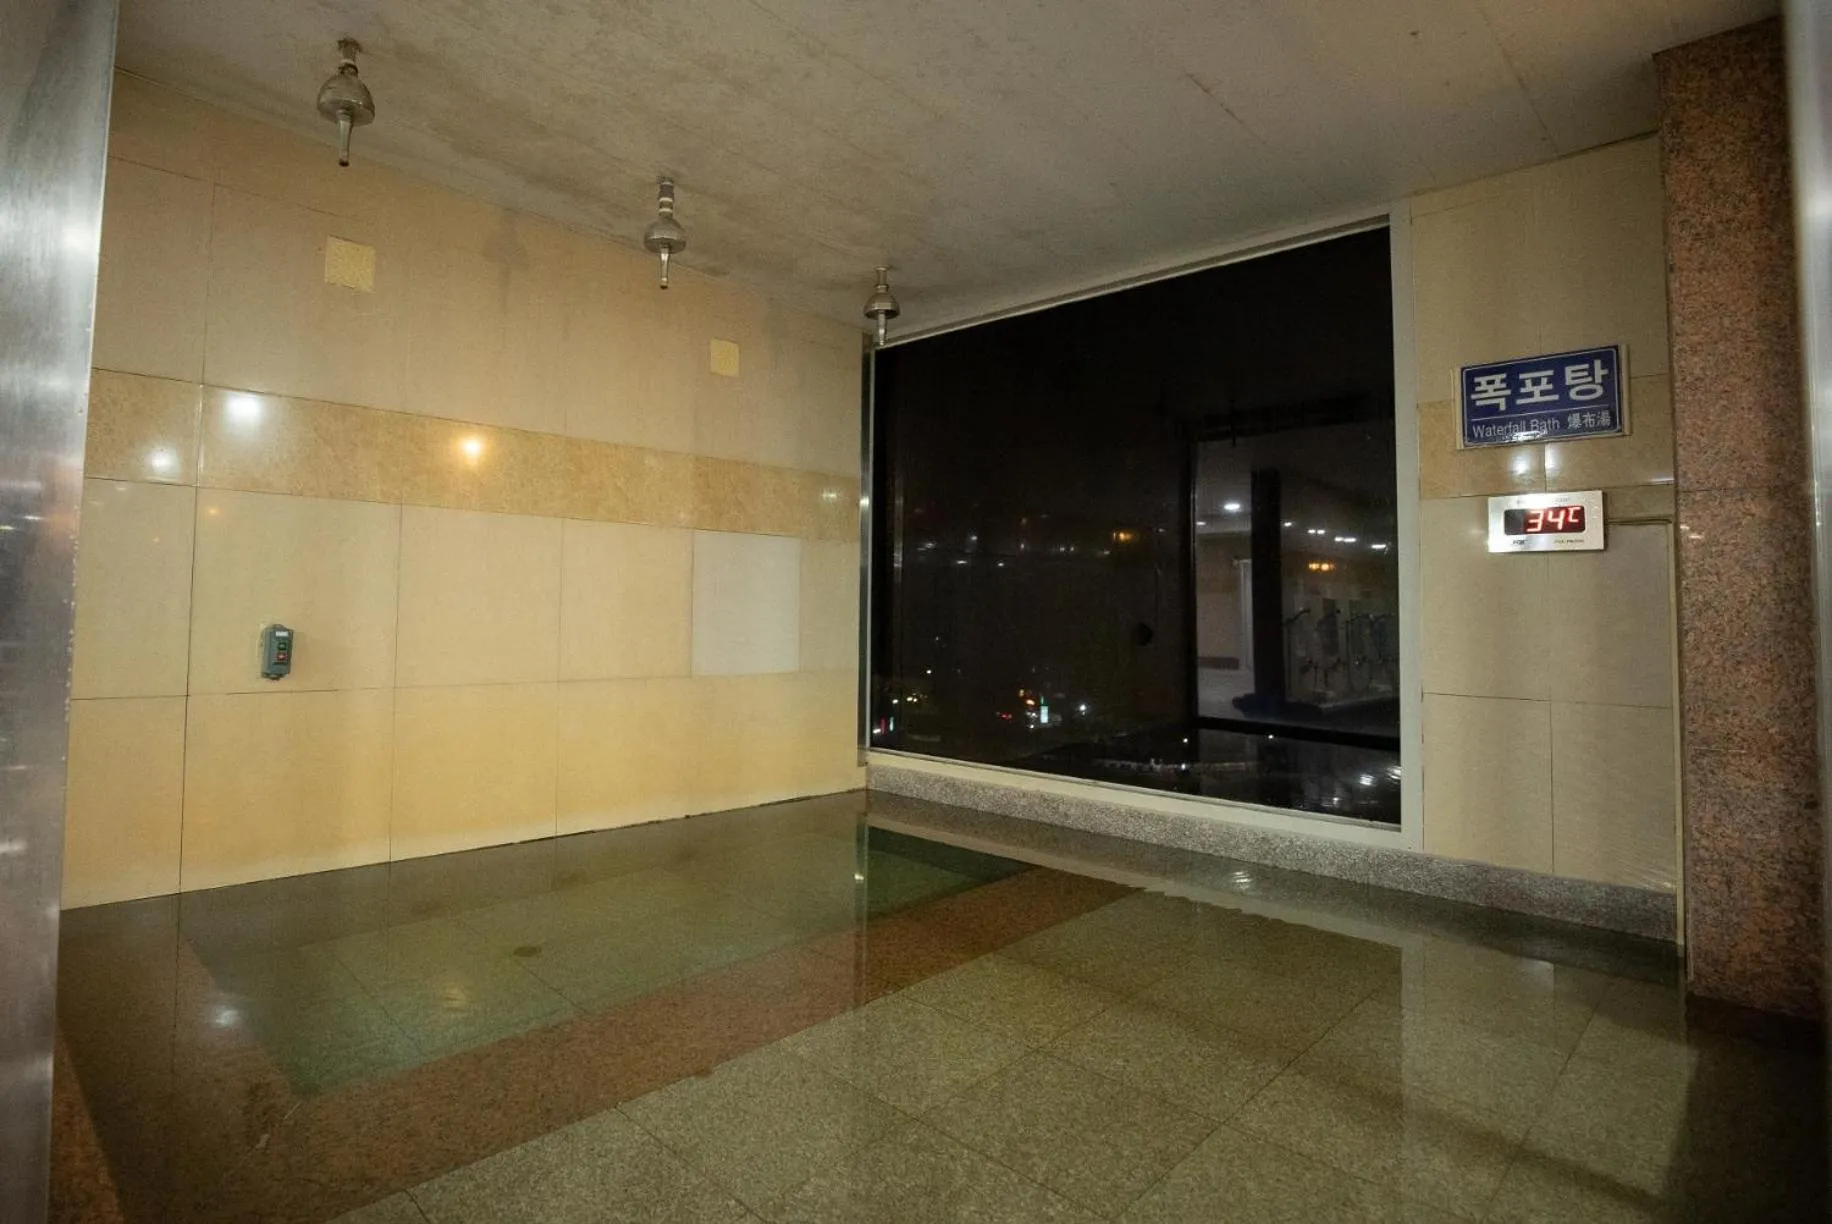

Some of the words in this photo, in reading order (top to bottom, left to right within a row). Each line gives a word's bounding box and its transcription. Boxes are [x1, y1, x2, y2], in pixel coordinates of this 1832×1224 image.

[1471, 359, 1608, 411] 폭포탕
[1472, 420, 1526, 438] Waterfall
[1530, 417, 1560, 435] Bath
